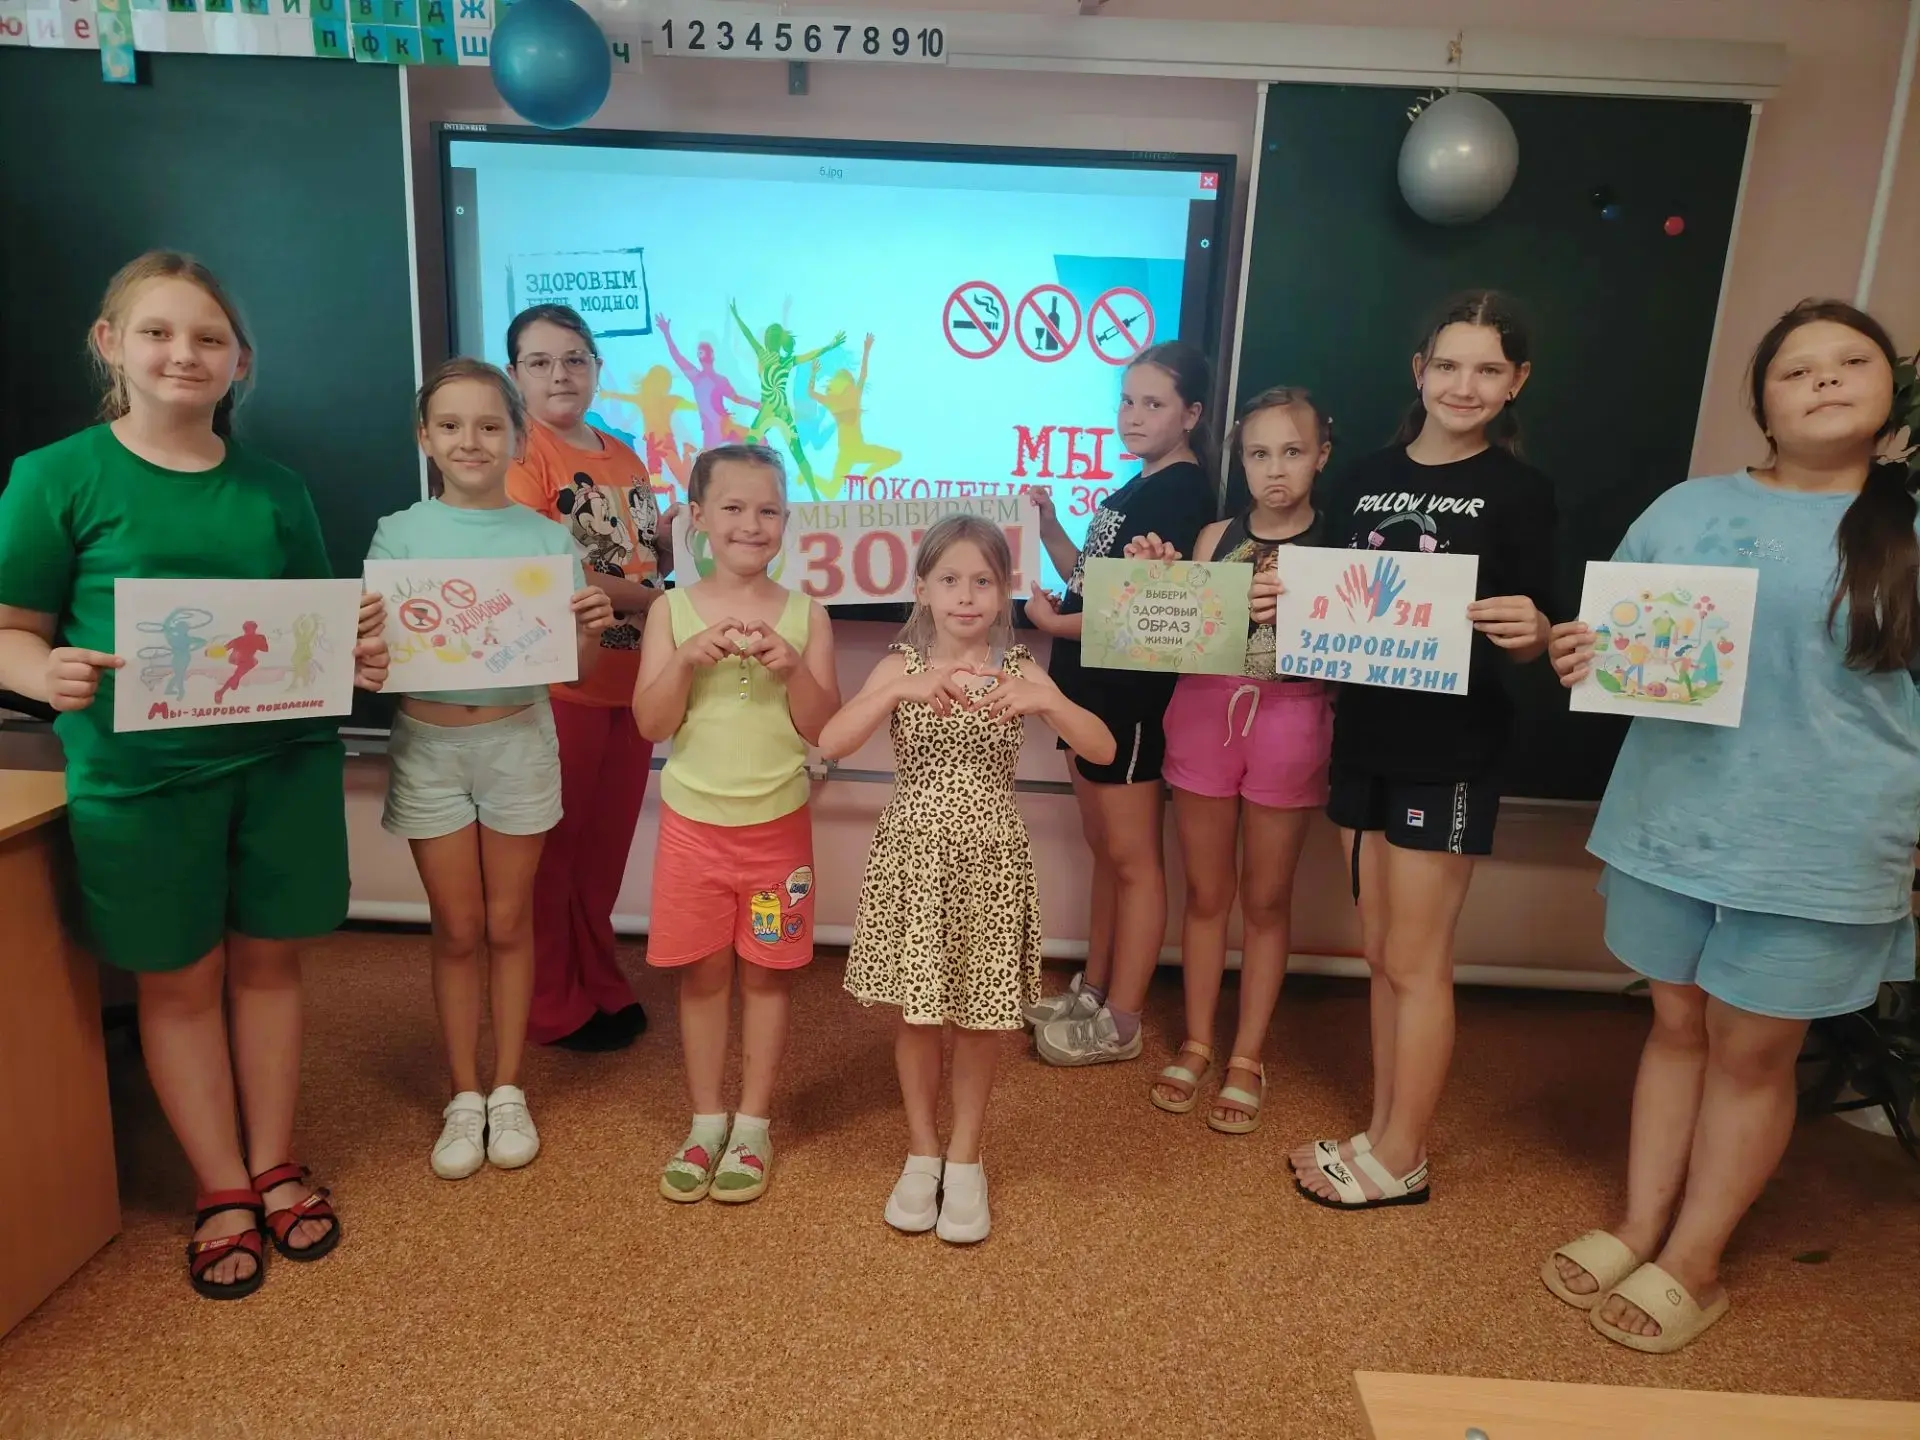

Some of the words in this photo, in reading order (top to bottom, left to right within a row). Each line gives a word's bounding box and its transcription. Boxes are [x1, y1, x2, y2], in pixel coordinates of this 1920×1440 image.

[661, 18, 673, 49] 1
[688, 20, 705, 50] 2
[717, 21, 735, 51] 3
[745, 22, 763, 51] 4
[774, 23, 793, 52] 5
[804, 24, 822, 53] 6
[833, 25, 851, 54] 7
[862, 26, 880, 55] 8
[892, 27, 910, 56] 9
[917, 27, 944, 58] 10
[526, 271, 637, 293] ЗДОРОВЫМ
[580, 295, 639, 312] МОДНО!
[798, 503, 849, 529] МЫ
[1353, 491, 1427, 515] FOLLOW
[1425, 494, 1485, 519] YOUR
[1145, 589, 1188, 600] ВЫБЕРИ
[1309, 595, 1329, 620] Я
[1393, 599, 1433, 628] ЗА
[1137, 617, 1191, 634] ОБРАЗ
[1144, 636, 1183, 645] ЖИЗНИ
[1300, 628, 1439, 661] ЗДОРОВЫЙ
[1281, 654, 1352, 680] ОБРАЗ
[1364, 663, 1459, 691] ЖИЗНИ
[256, 699, 325, 713] поколение
[1335, 1162, 1354, 1182] NIKE
